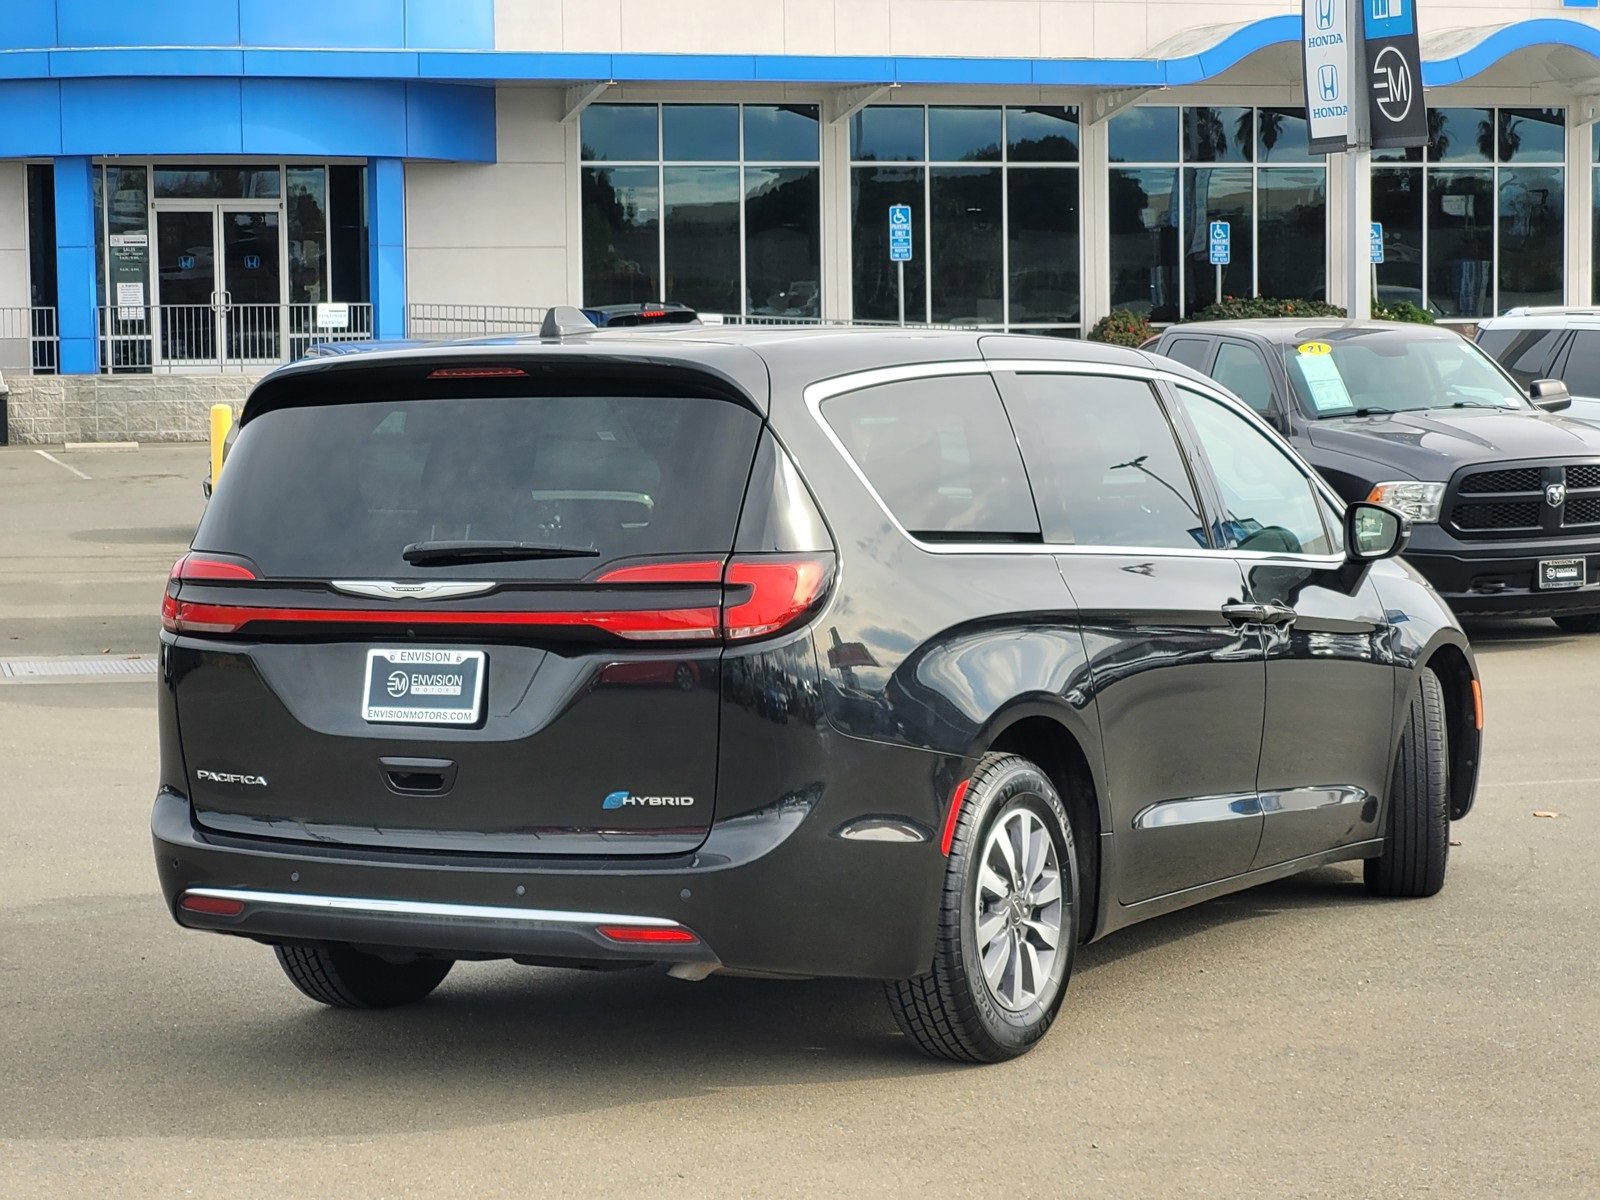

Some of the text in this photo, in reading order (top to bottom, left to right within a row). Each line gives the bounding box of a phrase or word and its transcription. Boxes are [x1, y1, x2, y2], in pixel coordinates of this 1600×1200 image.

[1308, 33, 1344, 48] HONDA
[1313, 105, 1348, 119] HONDA
[400, 651, 451, 662] ENVISION
[411, 674, 463, 686] ENVISION
[367, 709, 472, 721] ENVISIONMOTORS.COM
[196, 769, 268, 787] PACIFICA
[622, 796, 694, 806] HYBRID
